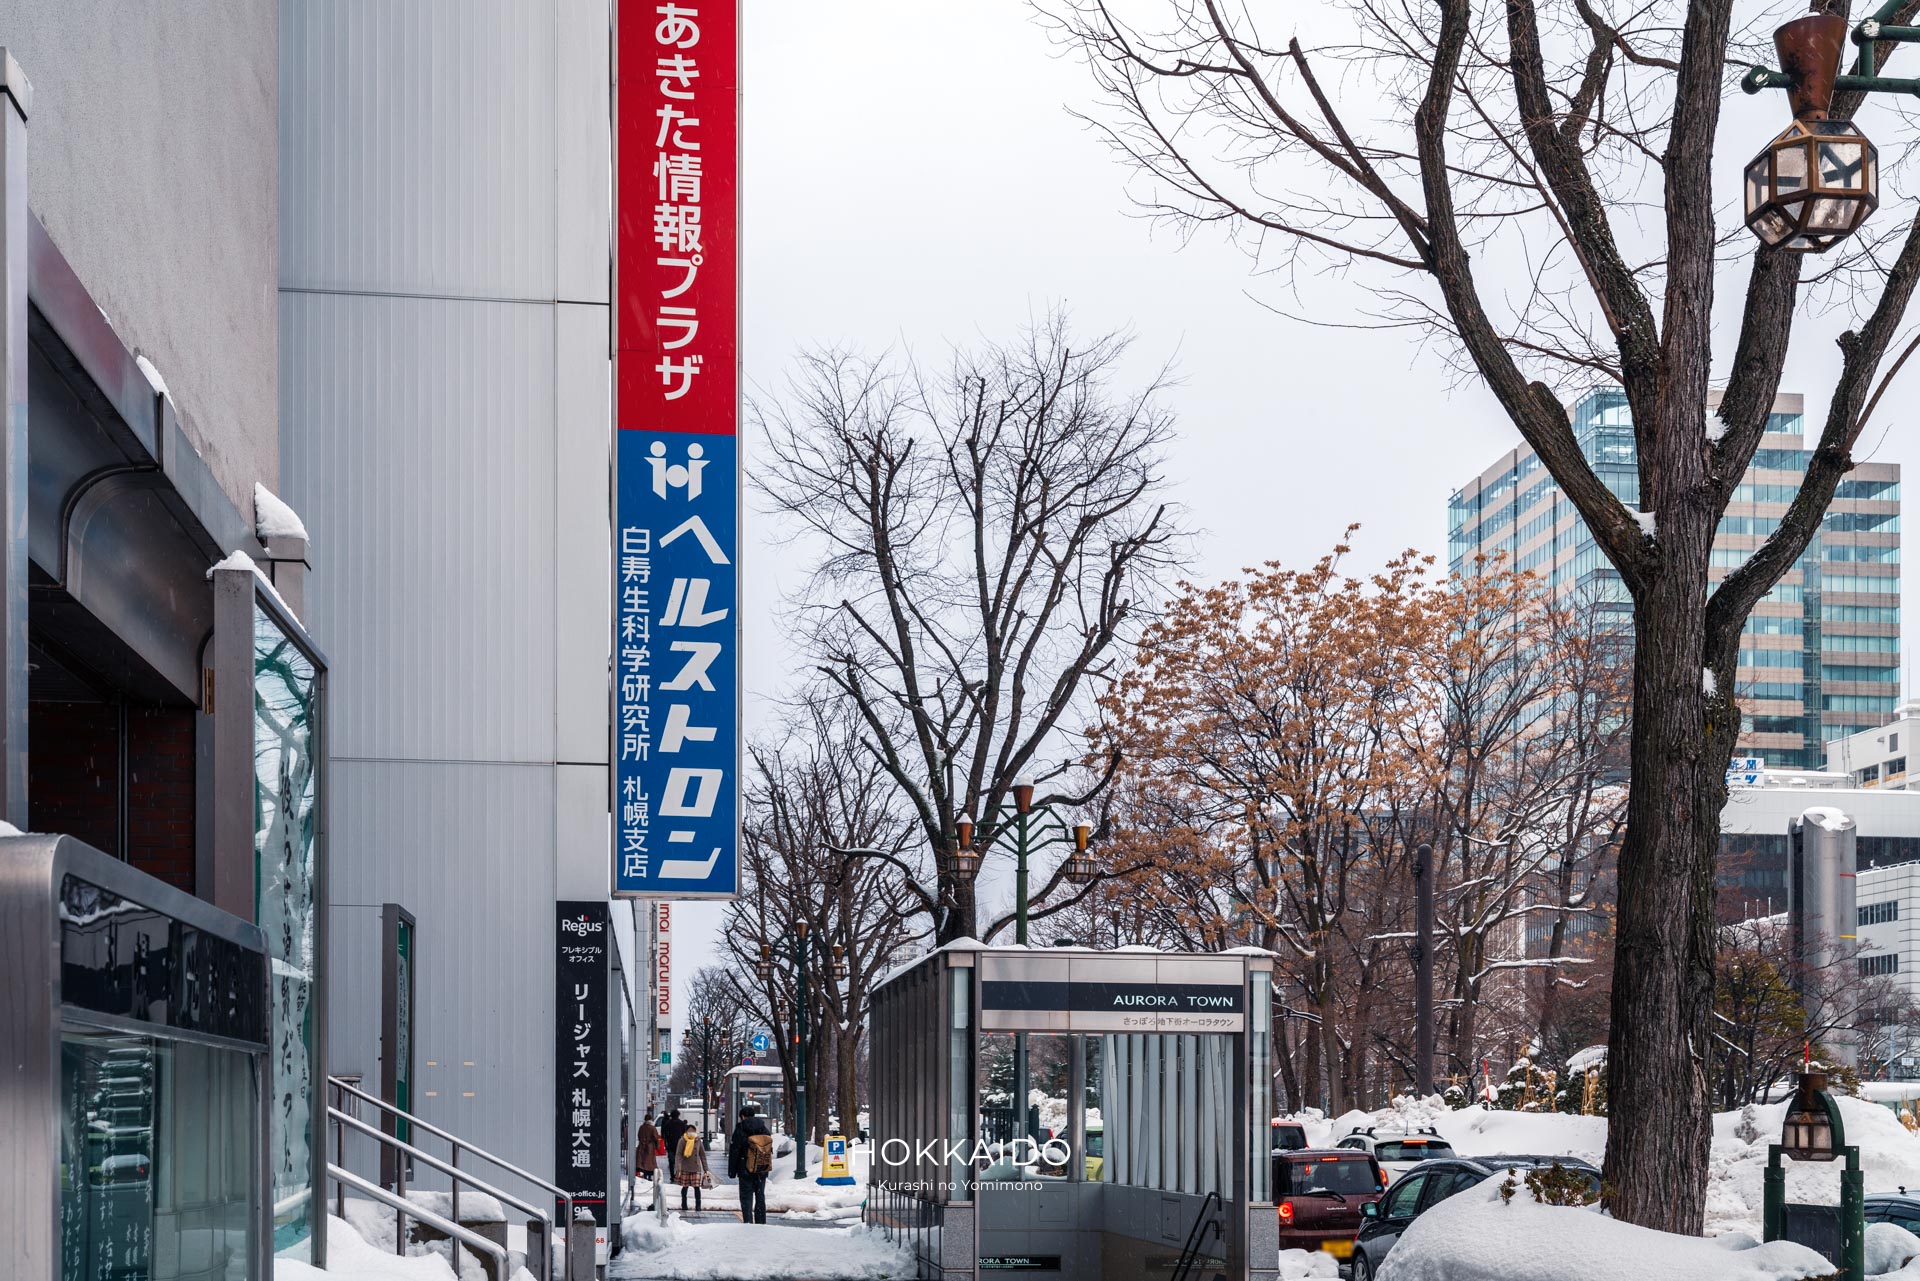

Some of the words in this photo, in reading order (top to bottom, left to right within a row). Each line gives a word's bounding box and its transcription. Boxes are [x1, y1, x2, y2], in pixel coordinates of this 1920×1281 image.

[653, 2, 703, 400] あきた情報プラザ
[621, 526, 651, 762] 白寿生科学研究所
[658, 514, 731, 879] ヘルストロン
[622, 775, 649, 879] 札幌支店
[562, 917, 603, 937] Regus
[562, 946, 602, 954] フレキシブル
[569, 955, 595, 963] オフィス
[572, 984, 592, 1078] リージャス
[1113, 994, 1178, 1007] AURORA
[1186, 996, 1233, 1007] TOWN
[571, 1088, 591, 1168] 札幌大通
[832, 1142, 840, 1151] P
